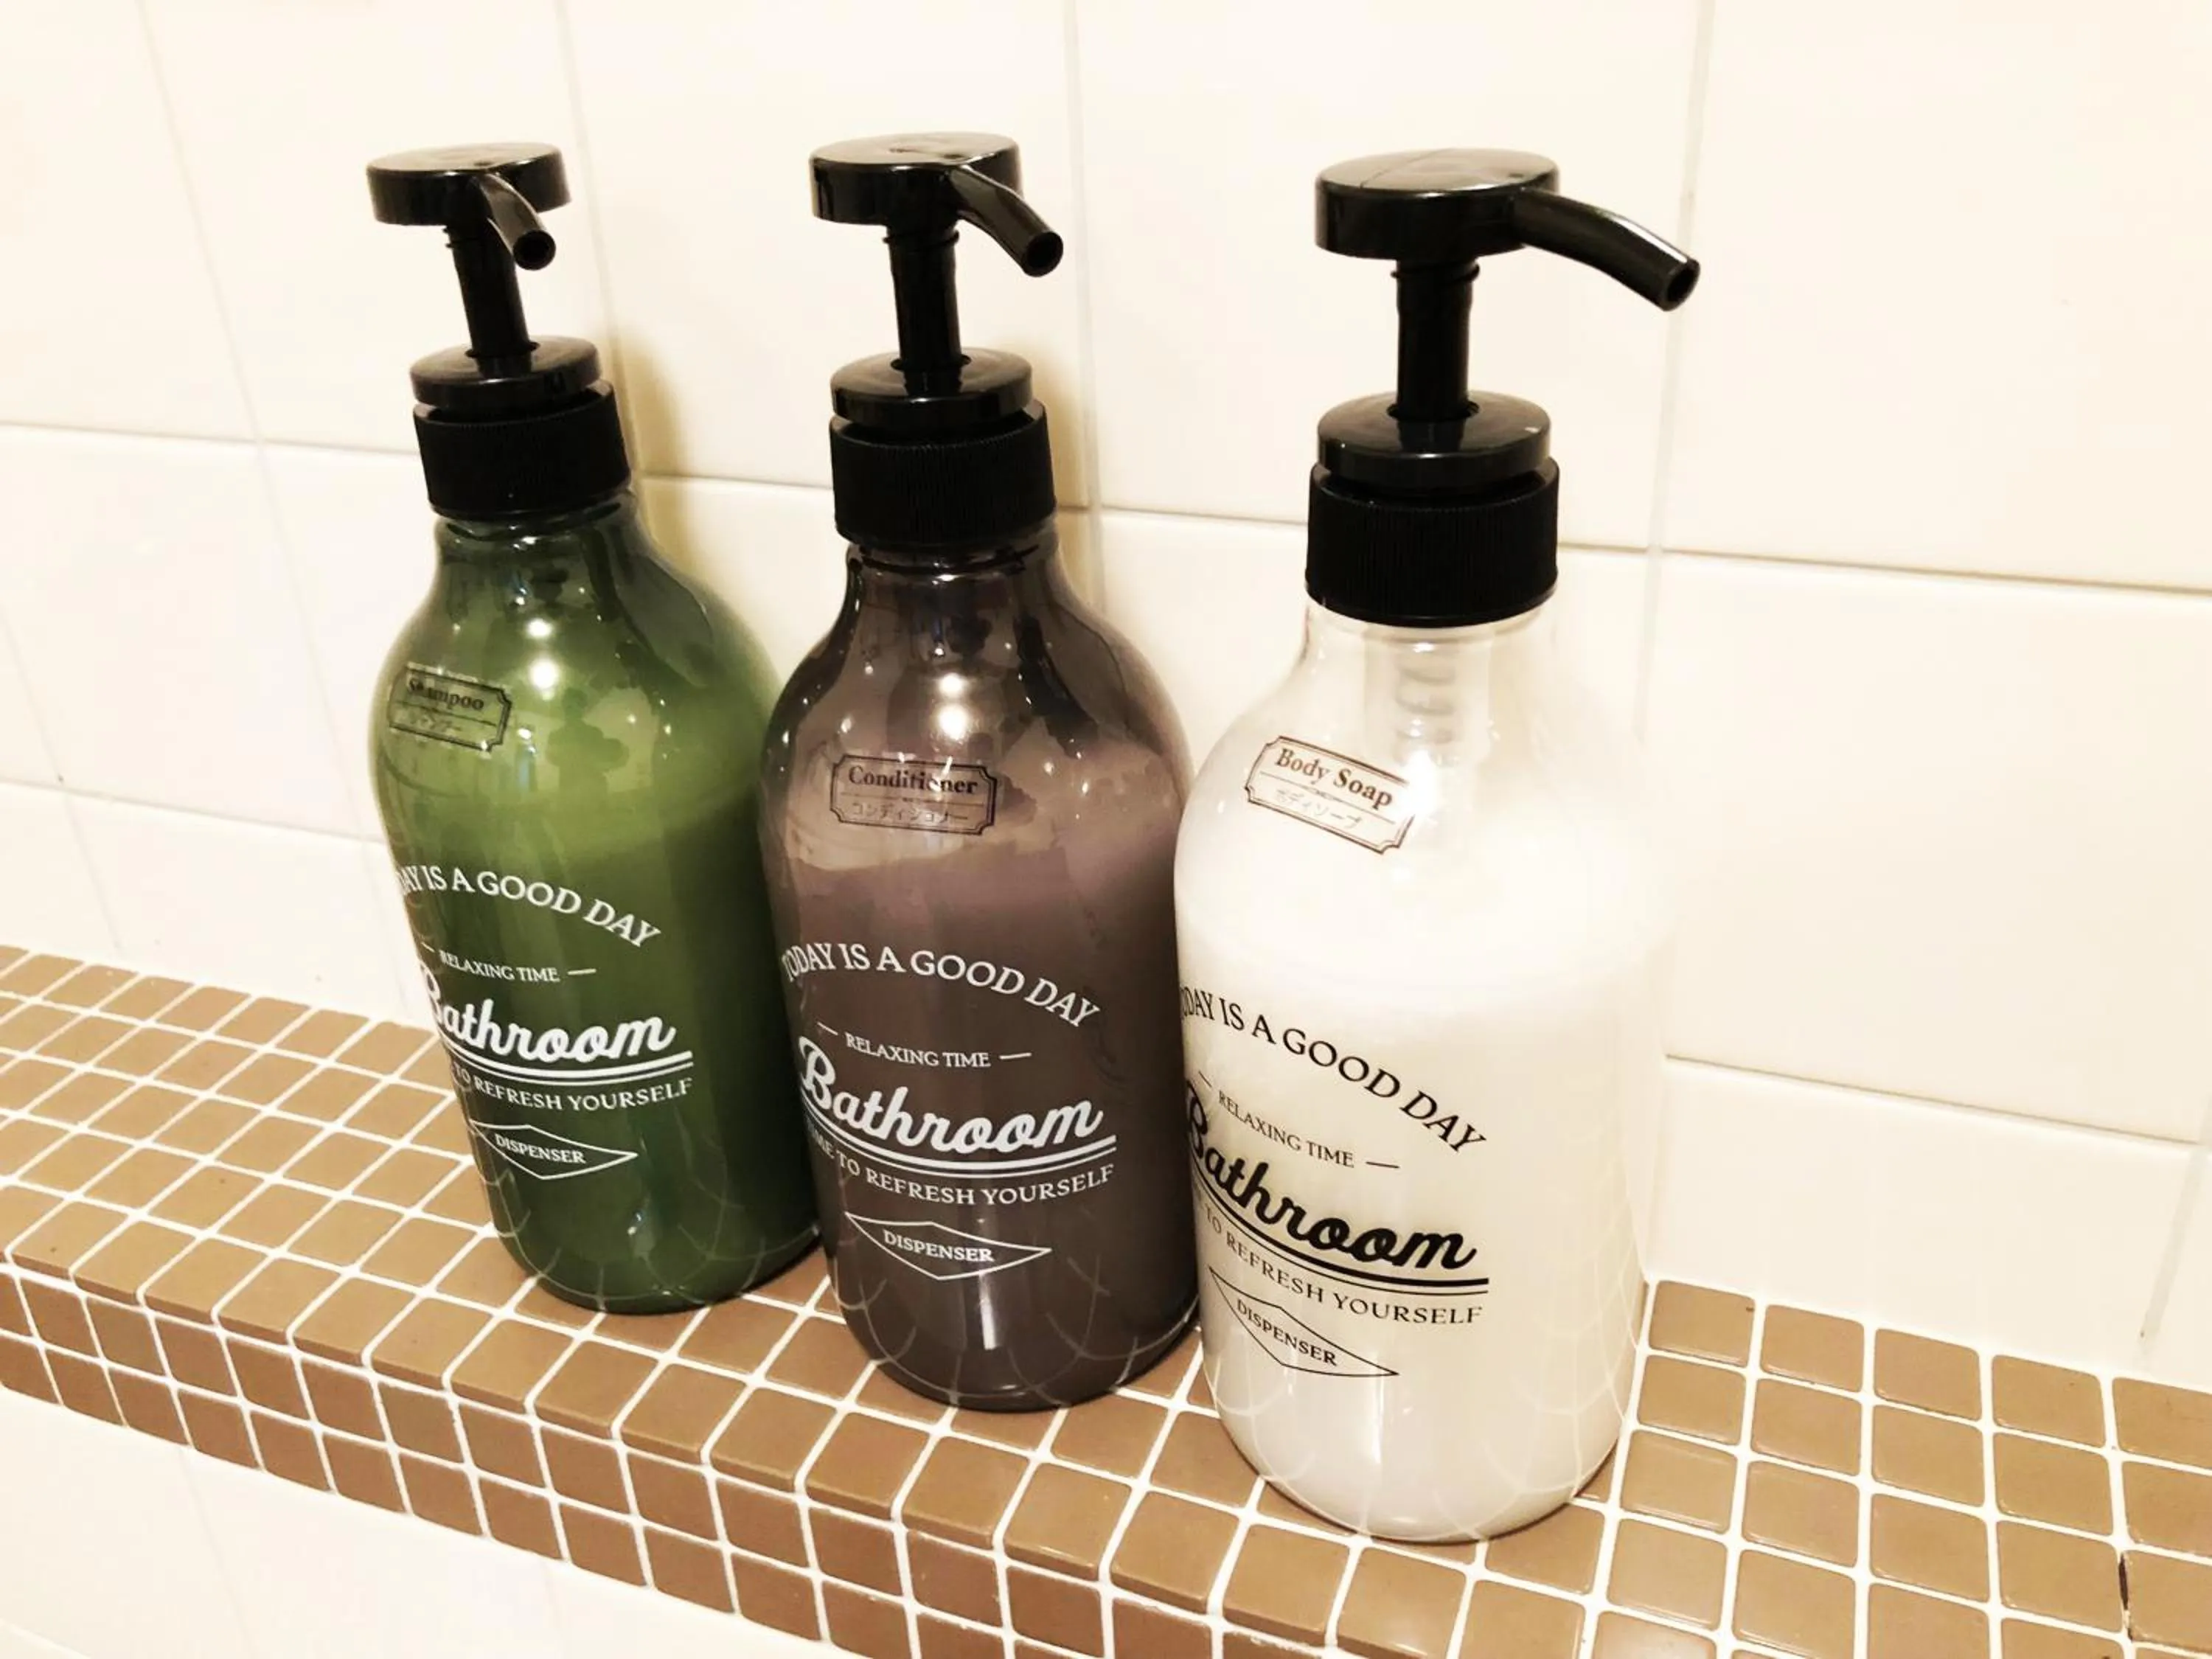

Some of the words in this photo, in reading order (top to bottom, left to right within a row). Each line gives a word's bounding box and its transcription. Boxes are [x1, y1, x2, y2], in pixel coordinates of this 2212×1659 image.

[1275, 748, 1330, 785] Body
[1333, 768, 1393, 811] Soap
[420, 865, 448, 891] IS
[451, 868, 476, 892] A
[477, 871, 582, 914] GOOD
[583, 898, 661, 947] DAY
[439, 949, 515, 981] RELAXING
[517, 967, 560, 982] TIME
[782, 942, 836, 982] TODAY
[838, 943, 870, 970] IS
[876, 946, 907, 973] A
[911, 950, 1026, 995] GOOD
[1024, 978, 1102, 1027] DAY
[845, 1032, 939, 1066] RELAXING
[942, 1051, 992, 1068] TIME
[1219, 997, 1245, 1031] IS
[1251, 1014, 1277, 1045] A
[1283, 1028, 1401, 1099] GOOD
[1399, 1090, 1486, 1154] DAY
[453, 1060, 472, 1085] TO
[474, 1076, 563, 1110] REFRESH
[568, 1077, 694, 1112] YOURSELF
[799, 1035, 1104, 1154] Bathroom
[495, 1133, 586, 1165] DISPENSER
[1218, 1090, 1302, 1151] RELAXING
[1306, 1140, 1355, 1168] TIME
[835, 1150, 860, 1176] TO
[866, 1166, 975, 1205] REFRESH
[981, 1164, 1114, 1206] YOURSELF
[1184, 1080, 1478, 1270] Bathroom
[883, 1228, 994, 1262] DISPENSER
[1205, 1203, 1222, 1234] TO
[1226, 1232, 1324, 1304] REFRESH
[1332, 1292, 1484, 1325] YOURSELF
[1237, 1298, 1338, 1367] DISPENSER
